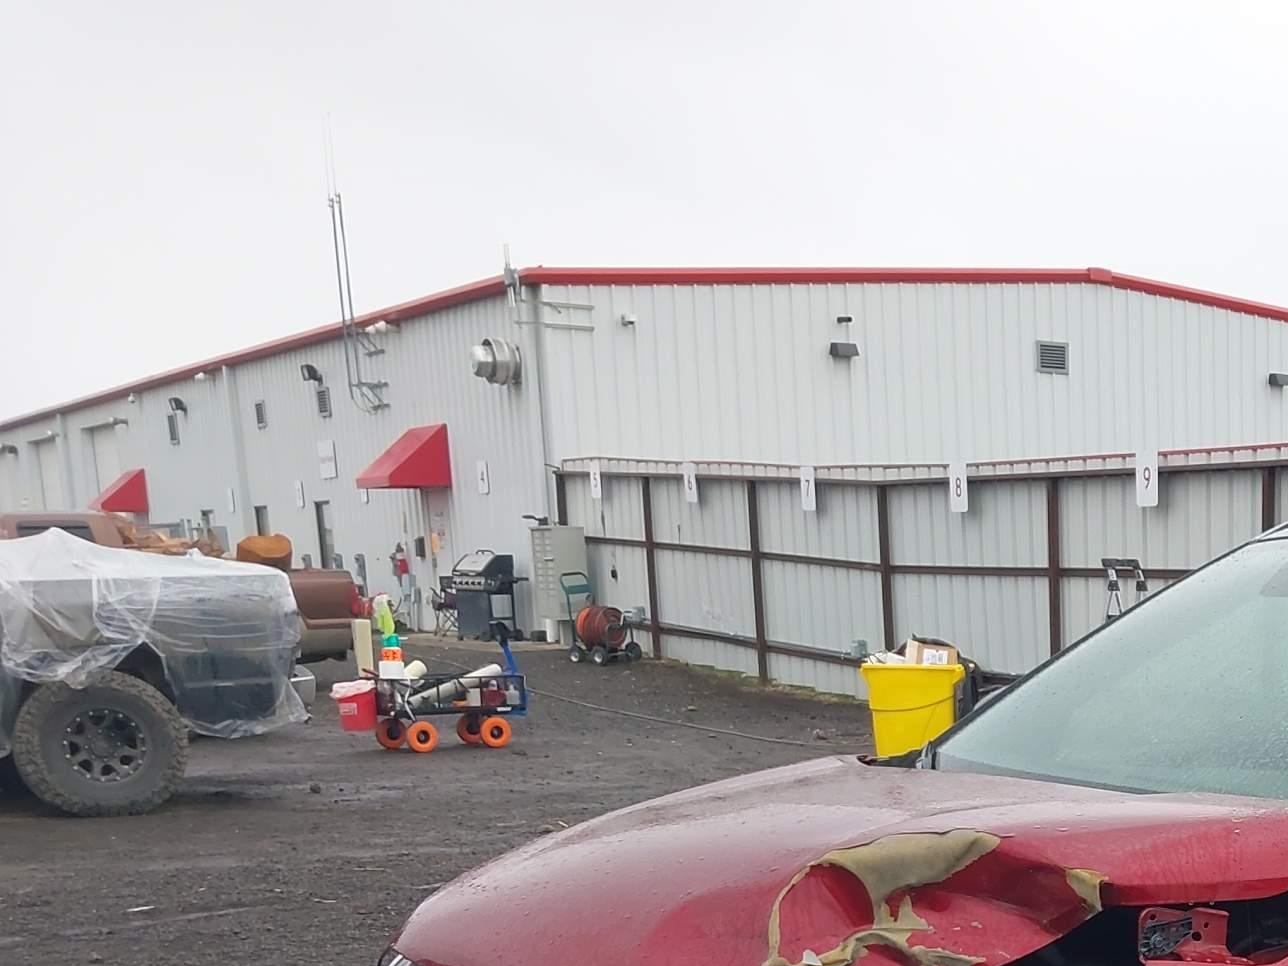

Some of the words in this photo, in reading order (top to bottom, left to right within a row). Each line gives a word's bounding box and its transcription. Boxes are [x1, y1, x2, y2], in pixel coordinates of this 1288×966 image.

[686, 475, 693, 491] 6
[804, 478, 811, 497] 7
[955, 476, 962, 498] 8
[1142, 466, 1152, 490] 9
